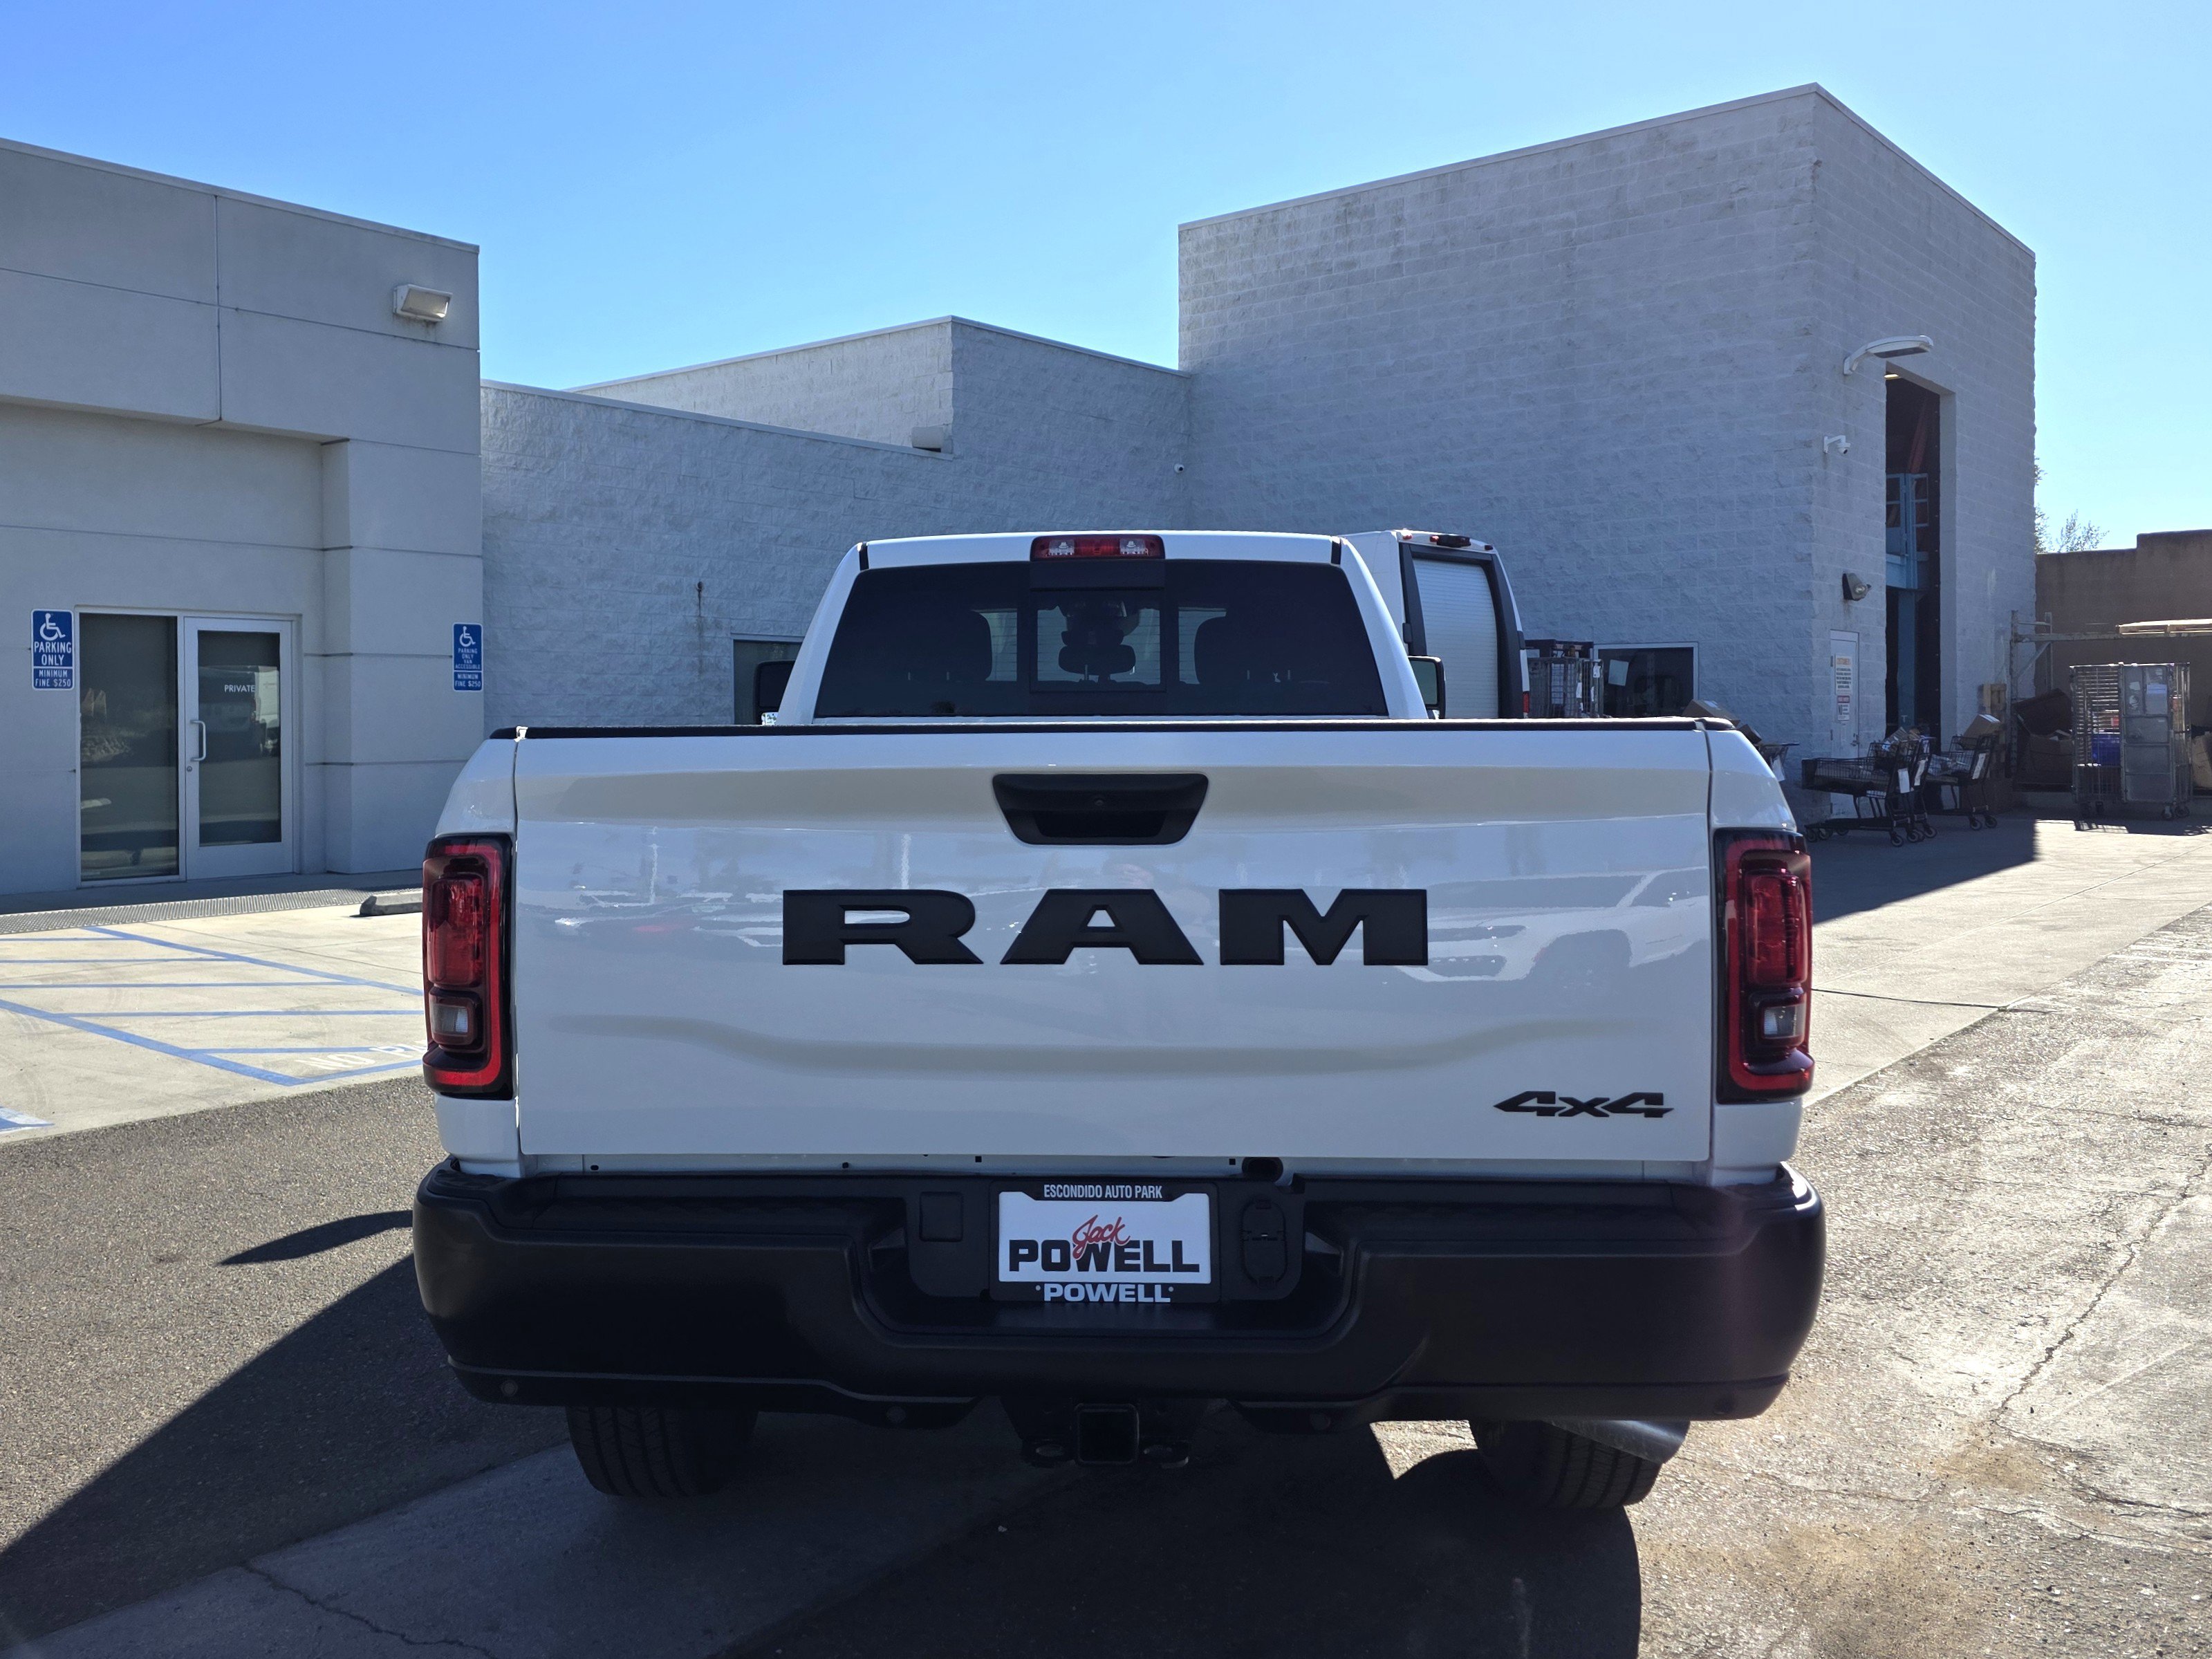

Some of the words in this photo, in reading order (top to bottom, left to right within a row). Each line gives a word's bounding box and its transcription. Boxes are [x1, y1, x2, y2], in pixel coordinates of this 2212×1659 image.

[34, 641, 72, 654] PARKING
[41, 654, 64, 666] ONLY
[39, 669, 68, 678] MINIMUM
[35, 678, 50, 687] FINE
[53, 678, 71, 687] $250
[224, 684, 255, 692] PRIVATE
[783, 889, 1429, 965] RAM
[295, 1053, 375, 1071] NO
[1492, 1091, 1675, 1118] 4x4
[1043, 1184, 1102, 1198] ESCONDIDO
[1105, 1185, 1132, 1198] AUTO
[1135, 1185, 1162, 1198] PARK
[1072, 1214, 1131, 1260] Jack
[1008, 1239, 1200, 1273] POWELL
[1043, 1283, 1171, 1303] POWELL
